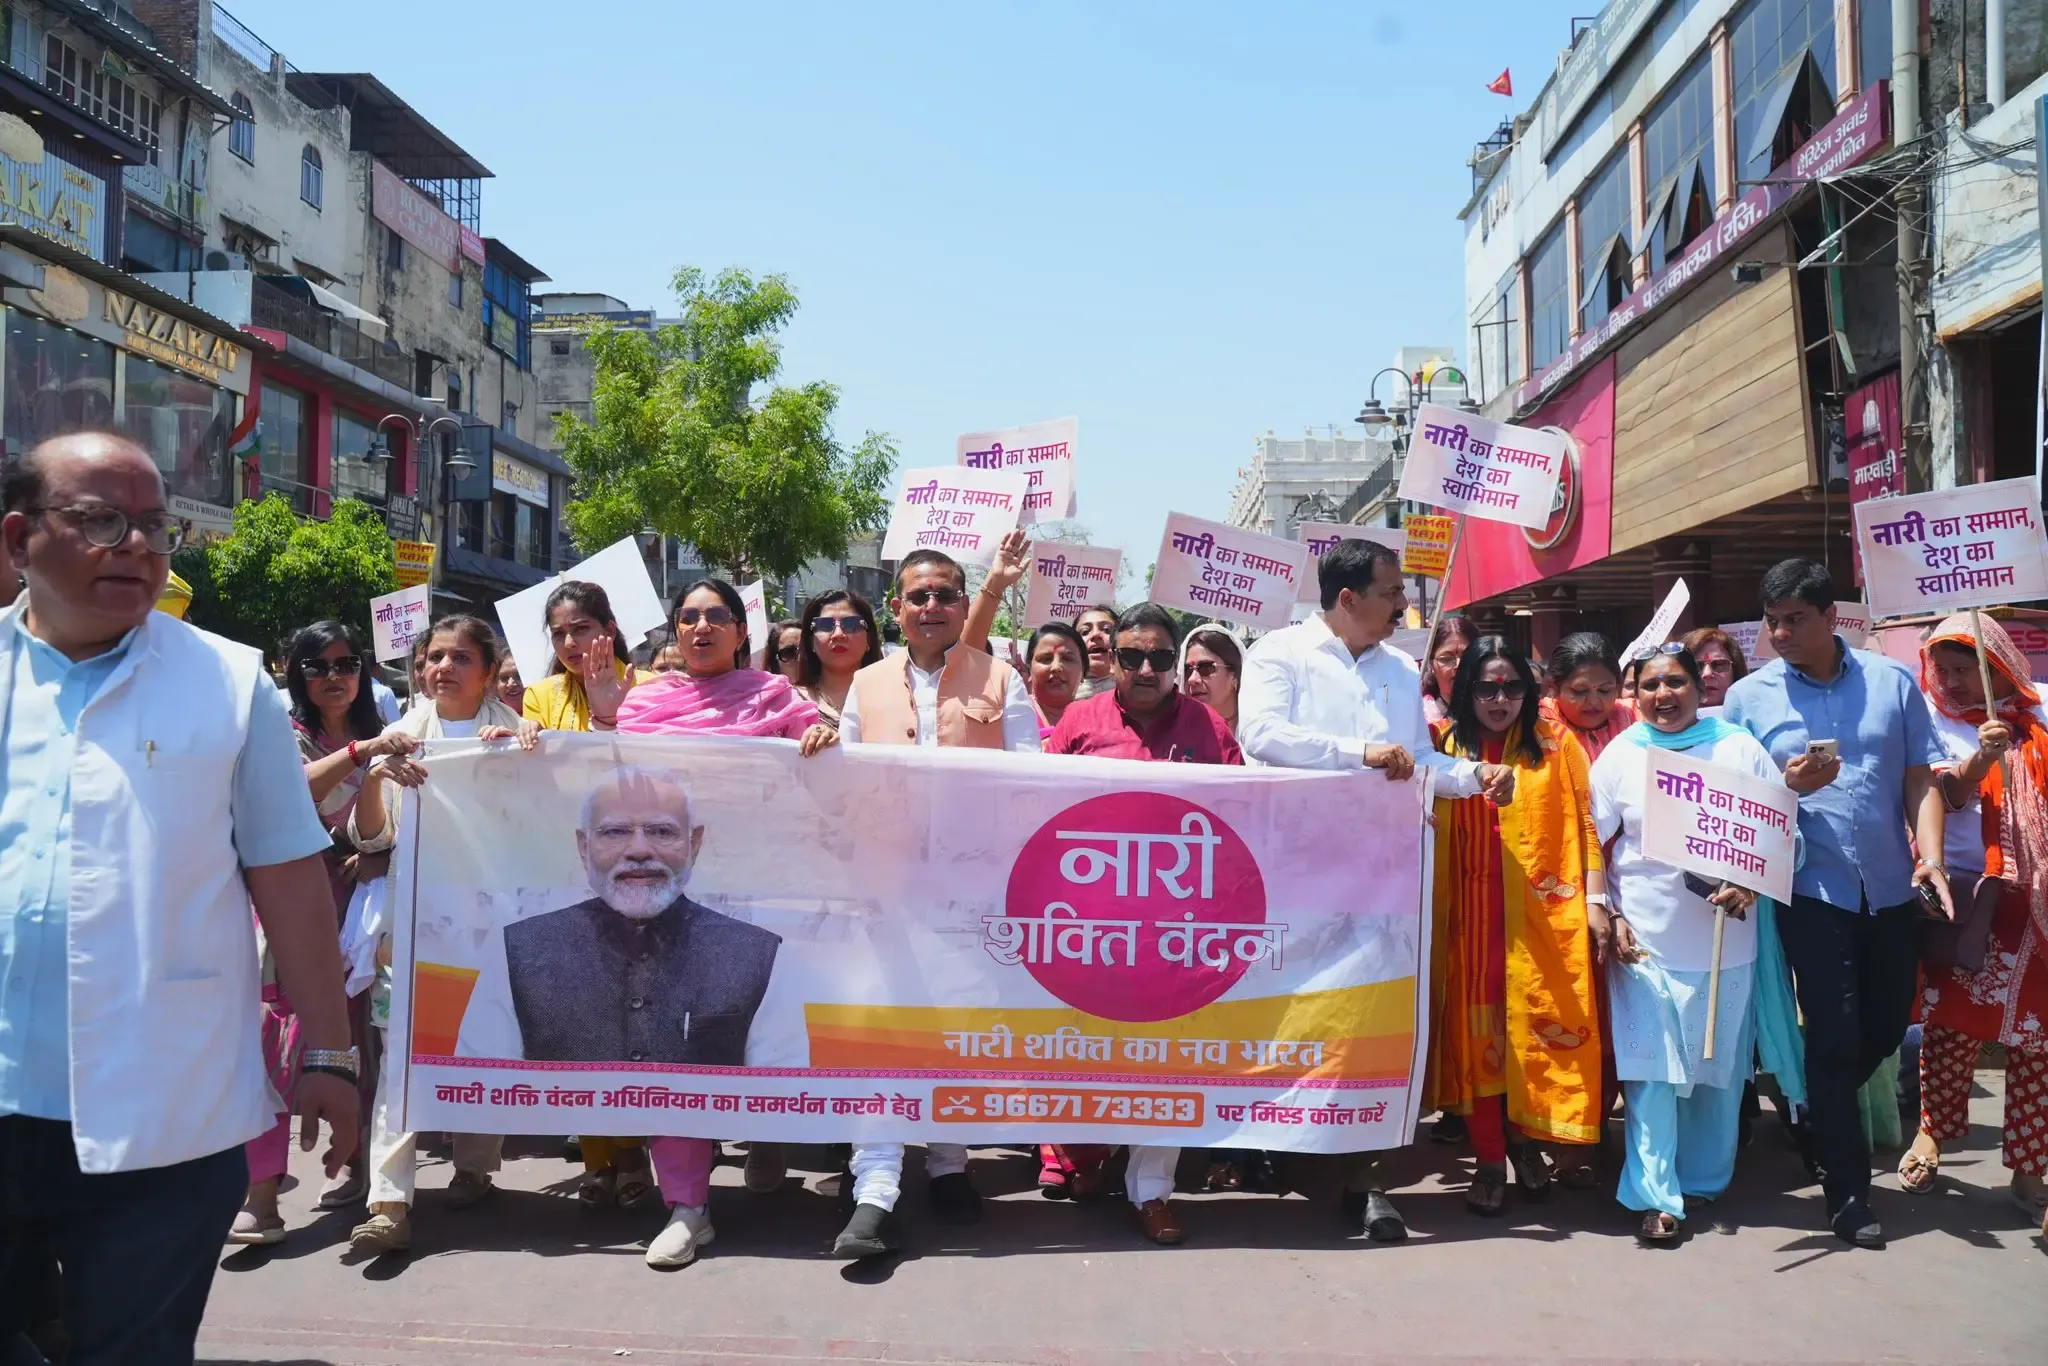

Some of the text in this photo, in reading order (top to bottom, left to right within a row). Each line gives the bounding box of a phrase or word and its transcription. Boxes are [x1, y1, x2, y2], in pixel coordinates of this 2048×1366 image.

[102, 288, 240, 373] NAZAKAT
[966, 441, 1071, 469] नारी का सम्मान,
[1425, 423, 1553, 475] नारी का सम्मान,
[1455, 454, 1512, 486] देश का
[1854, 448, 1897, 486] मारवाड़ी
[176, 500, 194, 512] RETAIL
[200, 506, 219, 517] WHOLE
[906, 479, 939, 505] नारी
[938, 487, 958, 504] का
[962, 488, 1014, 512] सम्मान,
[1442, 477, 1520, 510] स्वाभिमान
[927, 506, 975, 528] देश का
[1407, 517, 1452, 528] JAMAI
[1870, 507, 2035, 546] नारी का सम्मान,
[915, 526, 981, 550] स्वाभिमान
[1408, 529, 1446, 540] RAJA
[1037, 554, 1114, 584] नारी का सम्मान,
[1173, 531, 1294, 583] नारी का सम्मान,
[1923, 541, 1994, 569] देश का
[1058, 580, 1089, 600] देश का
[1202, 561, 1256, 592] देश का
[1916, 565, 2014, 596] स्वाभिमान
[376, 600, 425, 622] नारी का सम्मान,
[1189, 584, 1263, 616] स्वाभिमान
[393, 619, 413, 635] देश का
[1656, 770, 1791, 837] नारी का सम्मान,
[1697, 806, 1757, 846] देश का
[1056, 812, 1221, 898] नारी
[1685, 834, 1767, 877] स्वाभिमान
[981, 902, 1288, 972] शक्ति वंदन
[943, 1024, 1324, 1068] नारी शक्ति का नव भारत
[435, 1081, 1387, 1125] नारी शक्ति वंदन अधिनियम का समर्थन करने हेतु 96671 73333 पर मिस्ड कॉल करें
